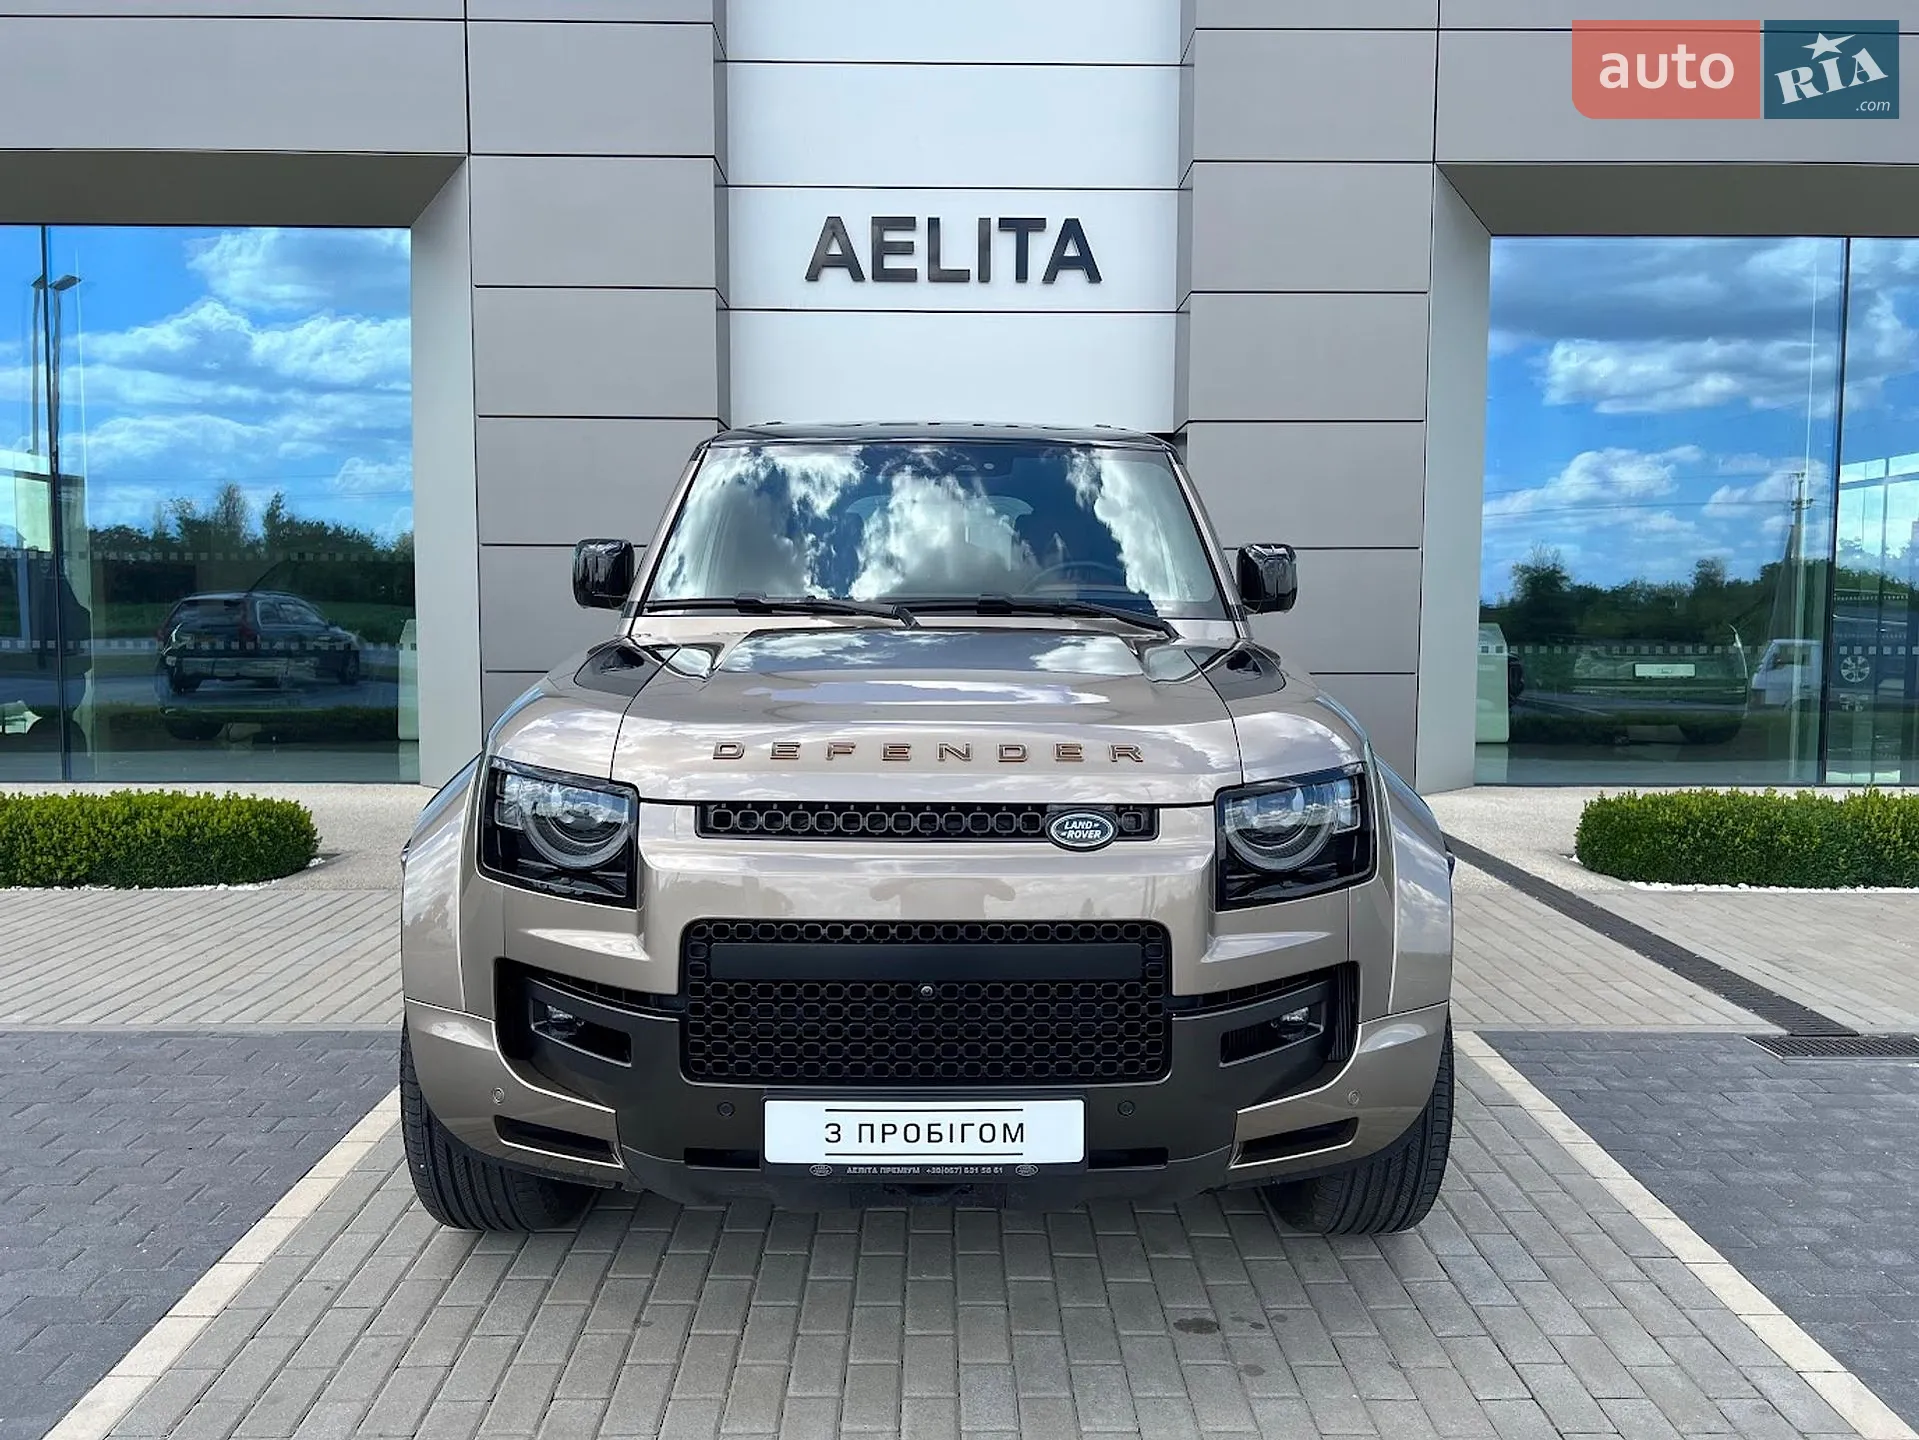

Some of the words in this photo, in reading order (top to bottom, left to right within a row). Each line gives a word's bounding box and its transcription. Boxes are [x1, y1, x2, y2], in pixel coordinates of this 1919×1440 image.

[805, 216, 1102, 284] AELITA
[713, 741, 1144, 762] DEFENDER
[1065, 821, 1093, 830] LAND
[1067, 829, 1102, 839] ROVER
[857, 1122, 1024, 1143] ПРОБІГОМ
